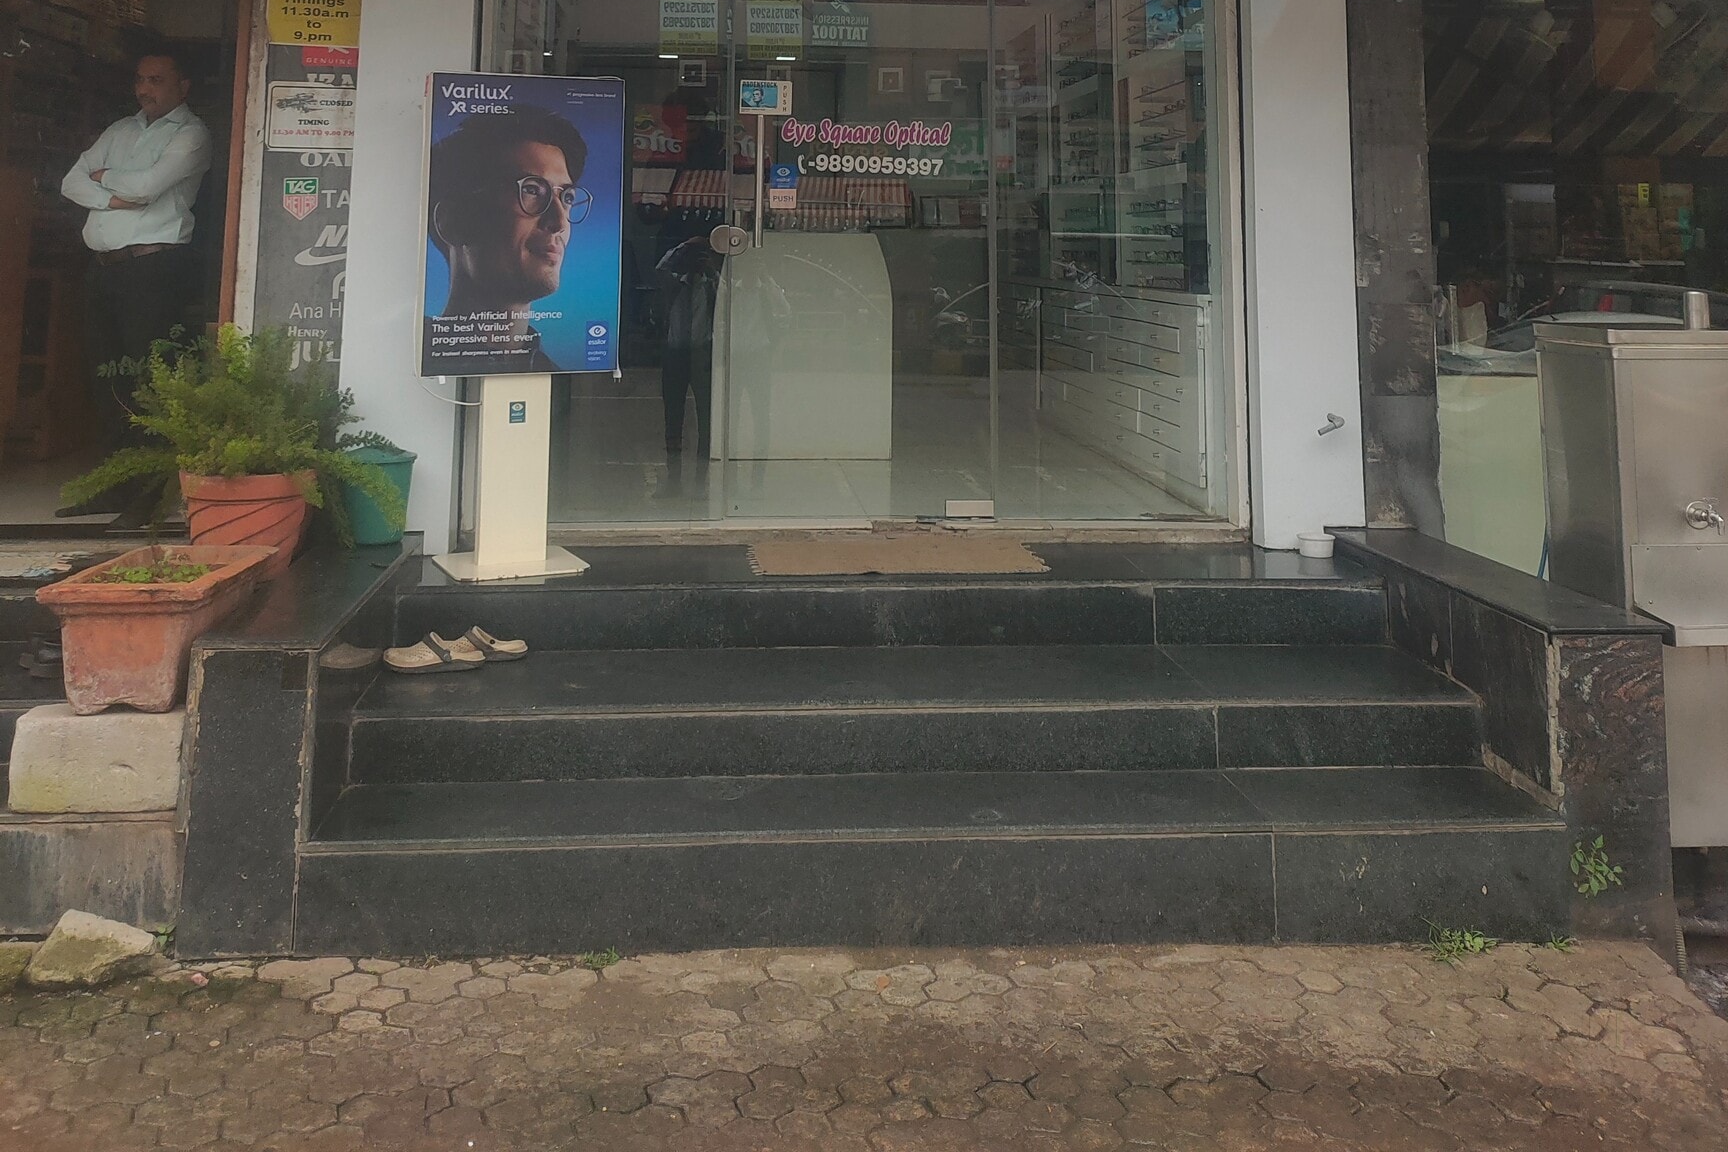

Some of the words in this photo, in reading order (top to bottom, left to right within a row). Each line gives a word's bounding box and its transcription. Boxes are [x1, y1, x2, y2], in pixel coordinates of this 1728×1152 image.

[306, 19, 323, 29] to
[781, 117, 817, 148] Eye
[818, 118, 880, 150] Square
[883, 119, 952, 150] Optical
[286, 180, 316, 194] TAG
[772, 194, 794, 203] PUSH
[289, 302, 324, 319] Ana
[469, 311, 508, 321] Artificial
[511, 310, 563, 322] Intelligence
[432, 324, 450, 333] The
[453, 323, 474, 332] best
[432, 334, 487, 346] progressive
[491, 334, 510, 342] lens
